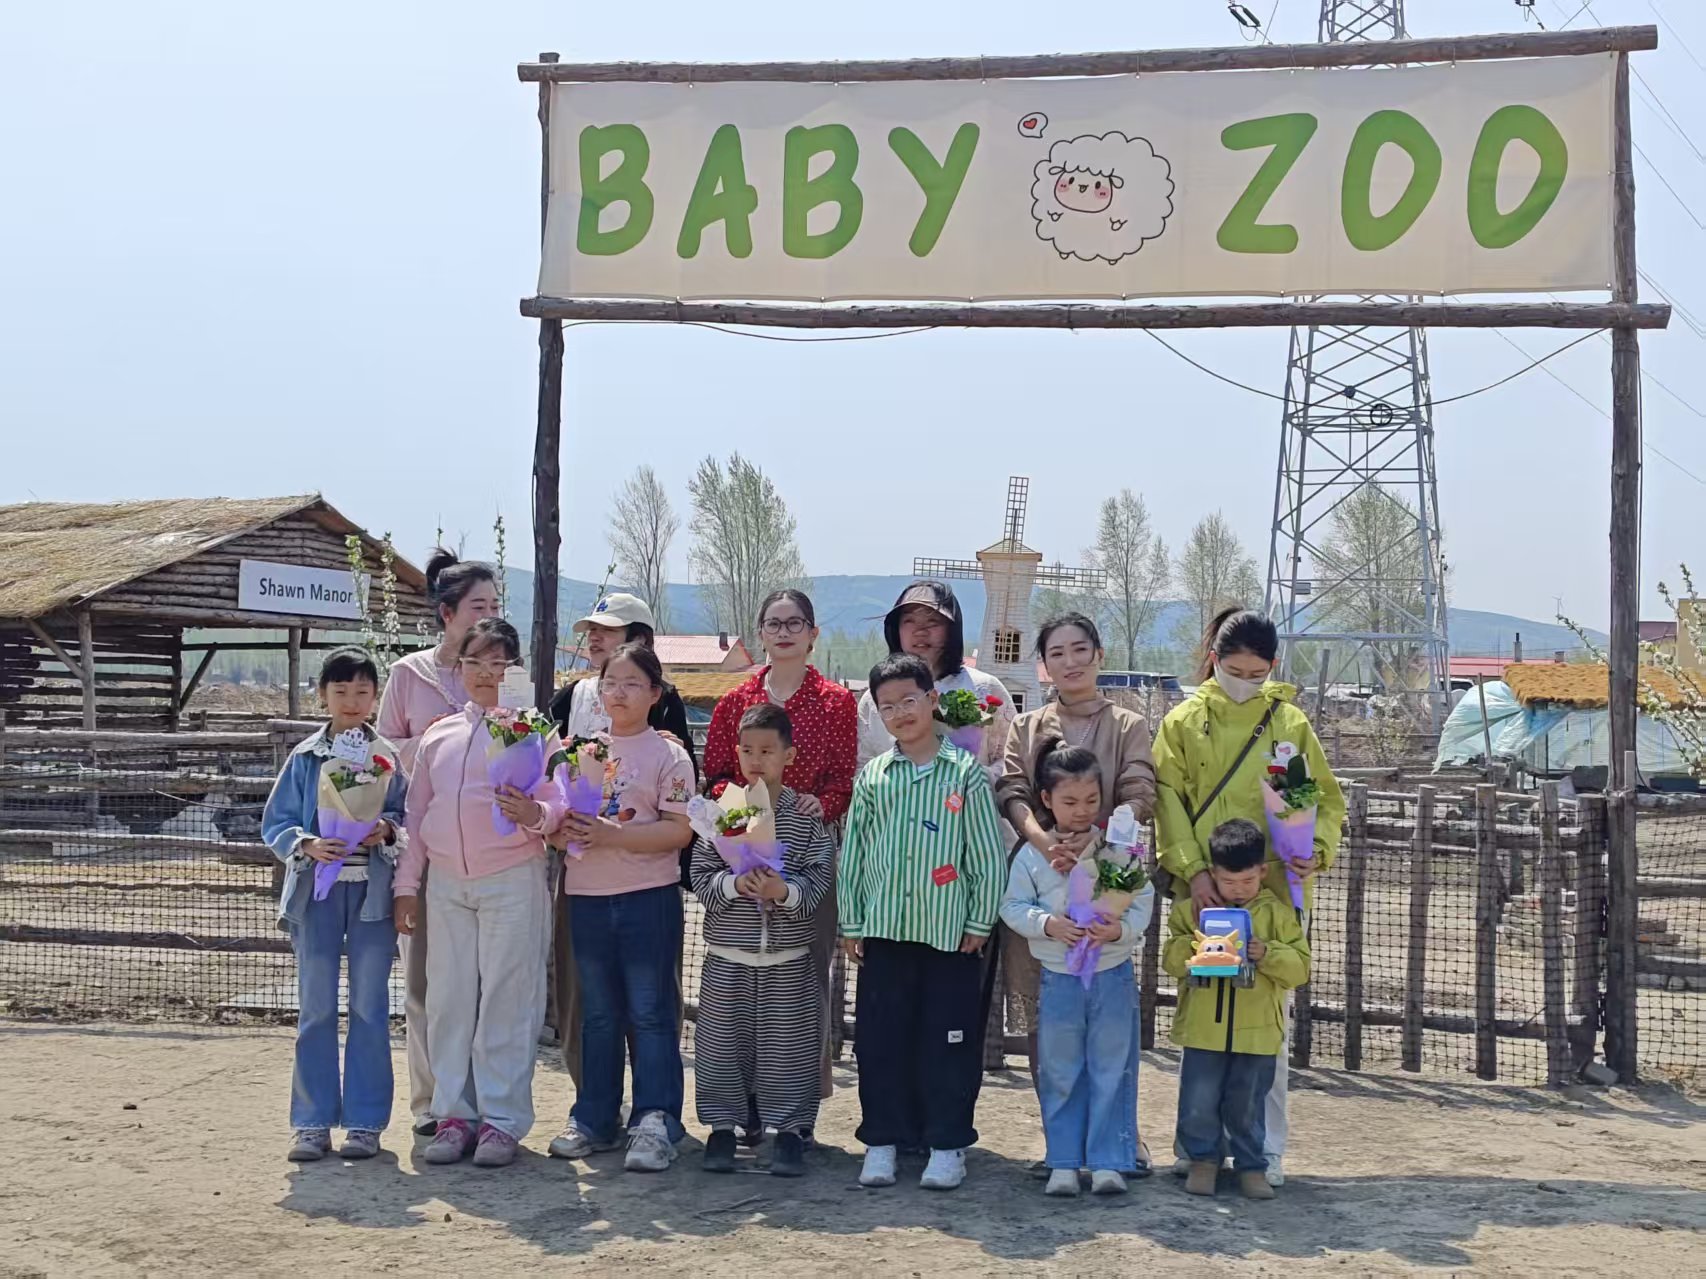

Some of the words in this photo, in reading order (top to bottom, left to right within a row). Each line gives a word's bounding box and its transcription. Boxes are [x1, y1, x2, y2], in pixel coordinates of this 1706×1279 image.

[578, 124, 978, 259] BABY
[1217, 105, 1568, 252] ZOO
[259, 577, 305, 599] Shawn
[310, 583, 353, 603] Manor
